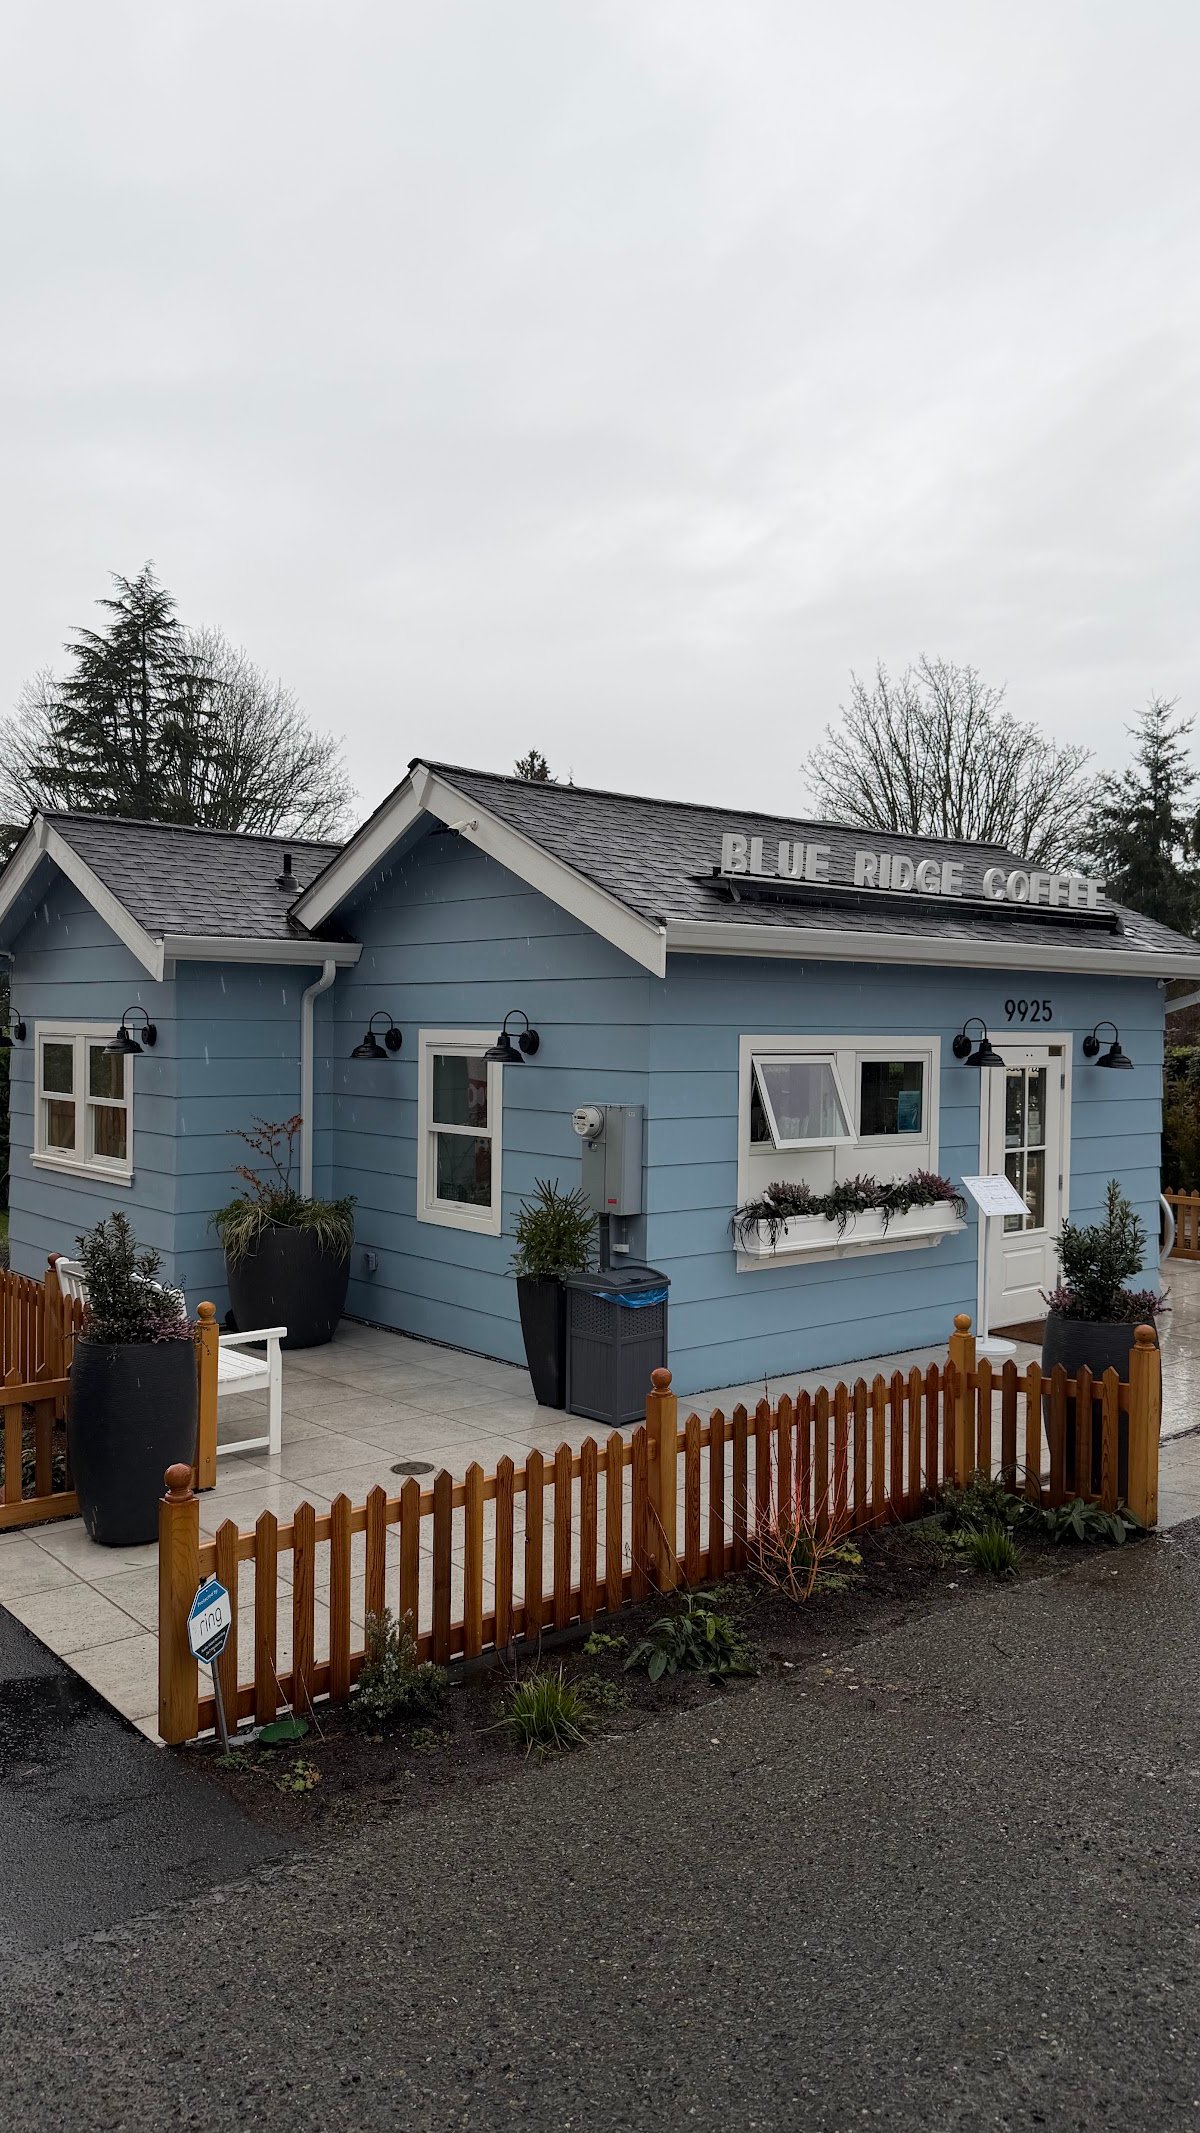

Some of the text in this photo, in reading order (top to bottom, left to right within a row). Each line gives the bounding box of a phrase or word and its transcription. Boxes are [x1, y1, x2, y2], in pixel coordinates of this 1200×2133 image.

[721, 833, 1107, 910] BLUE RIDGE COFFEE
[1004, 999, 1053, 1022] 9925
[200, 1607, 222, 1636] ring
